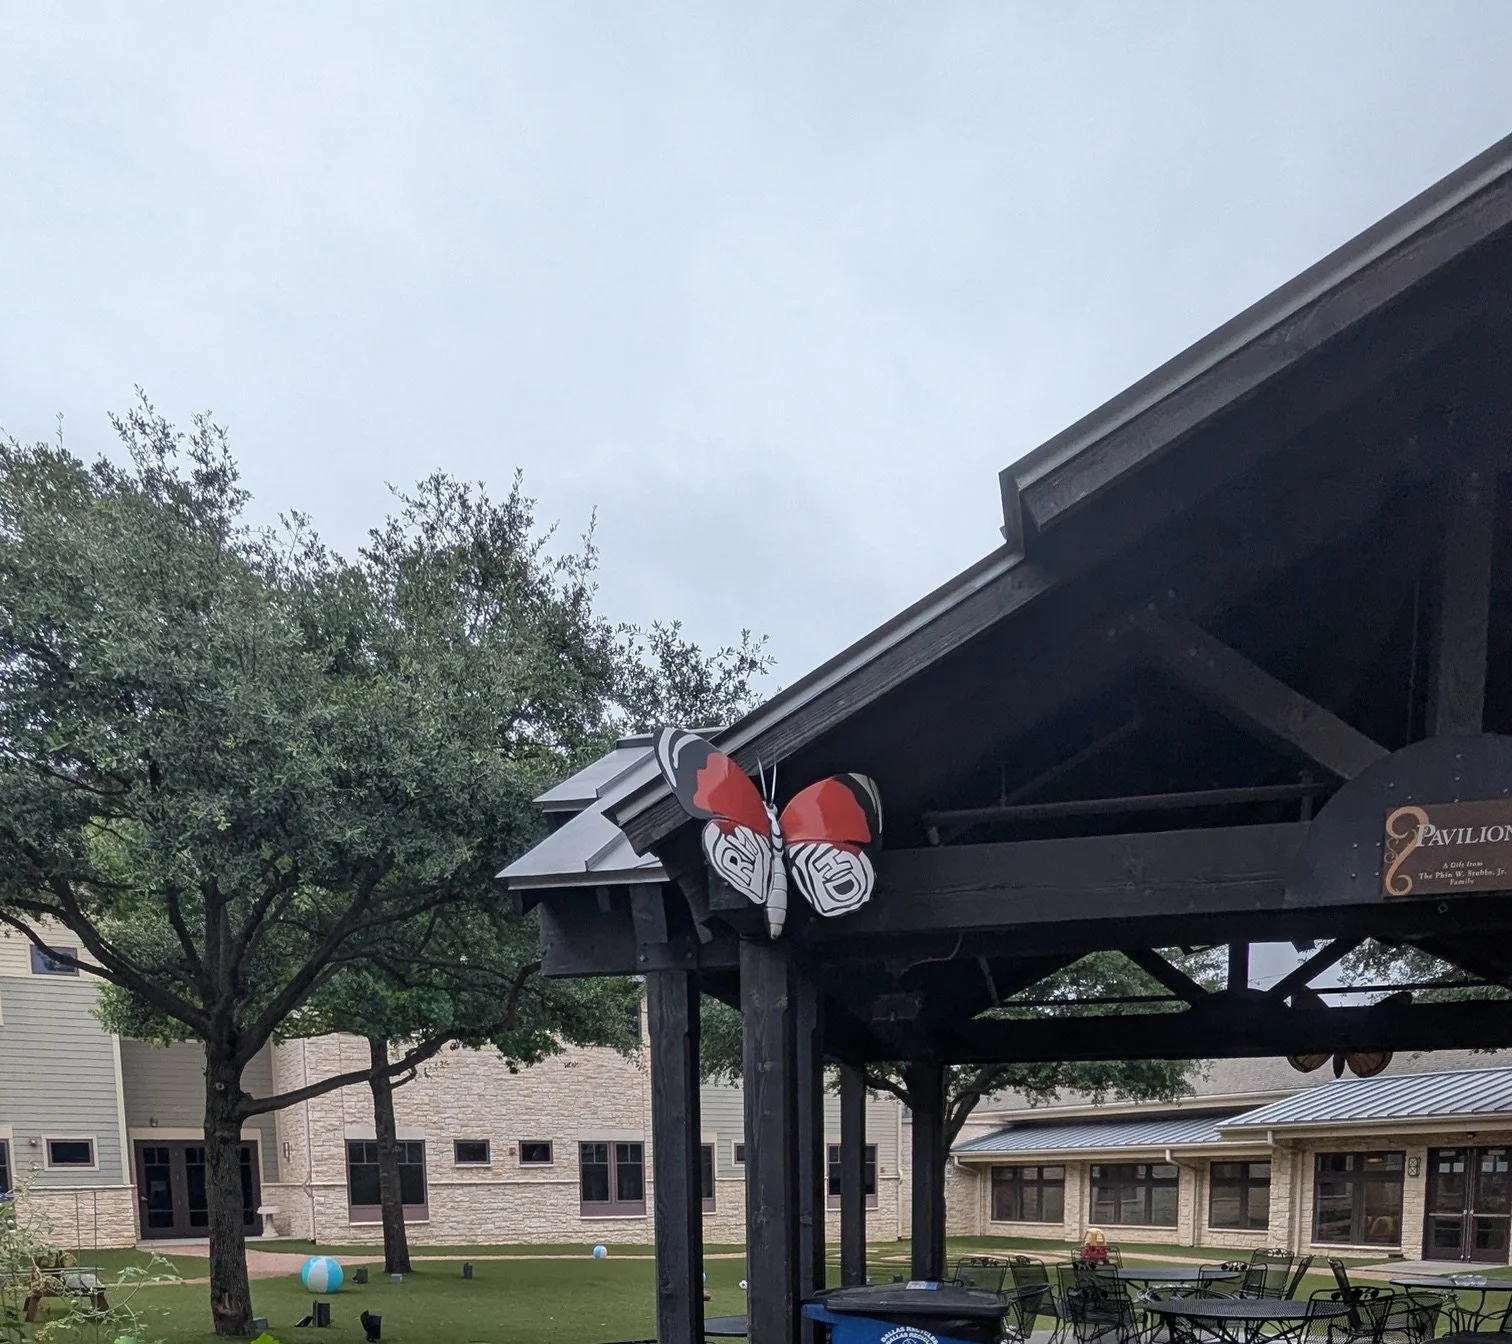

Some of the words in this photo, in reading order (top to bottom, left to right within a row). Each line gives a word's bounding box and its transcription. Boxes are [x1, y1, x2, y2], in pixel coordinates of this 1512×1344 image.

[1416, 824, 1512, 847] PAVILION
[1450, 861, 1465, 869] Gift
[1466, 860, 1483, 868] from
[1418, 872, 1433, 880] The
[1496, 867, 1507, 877] Jr.
[1449, 877, 1475, 886] Family
[880, 1326, 905, 1343] DALLAS
